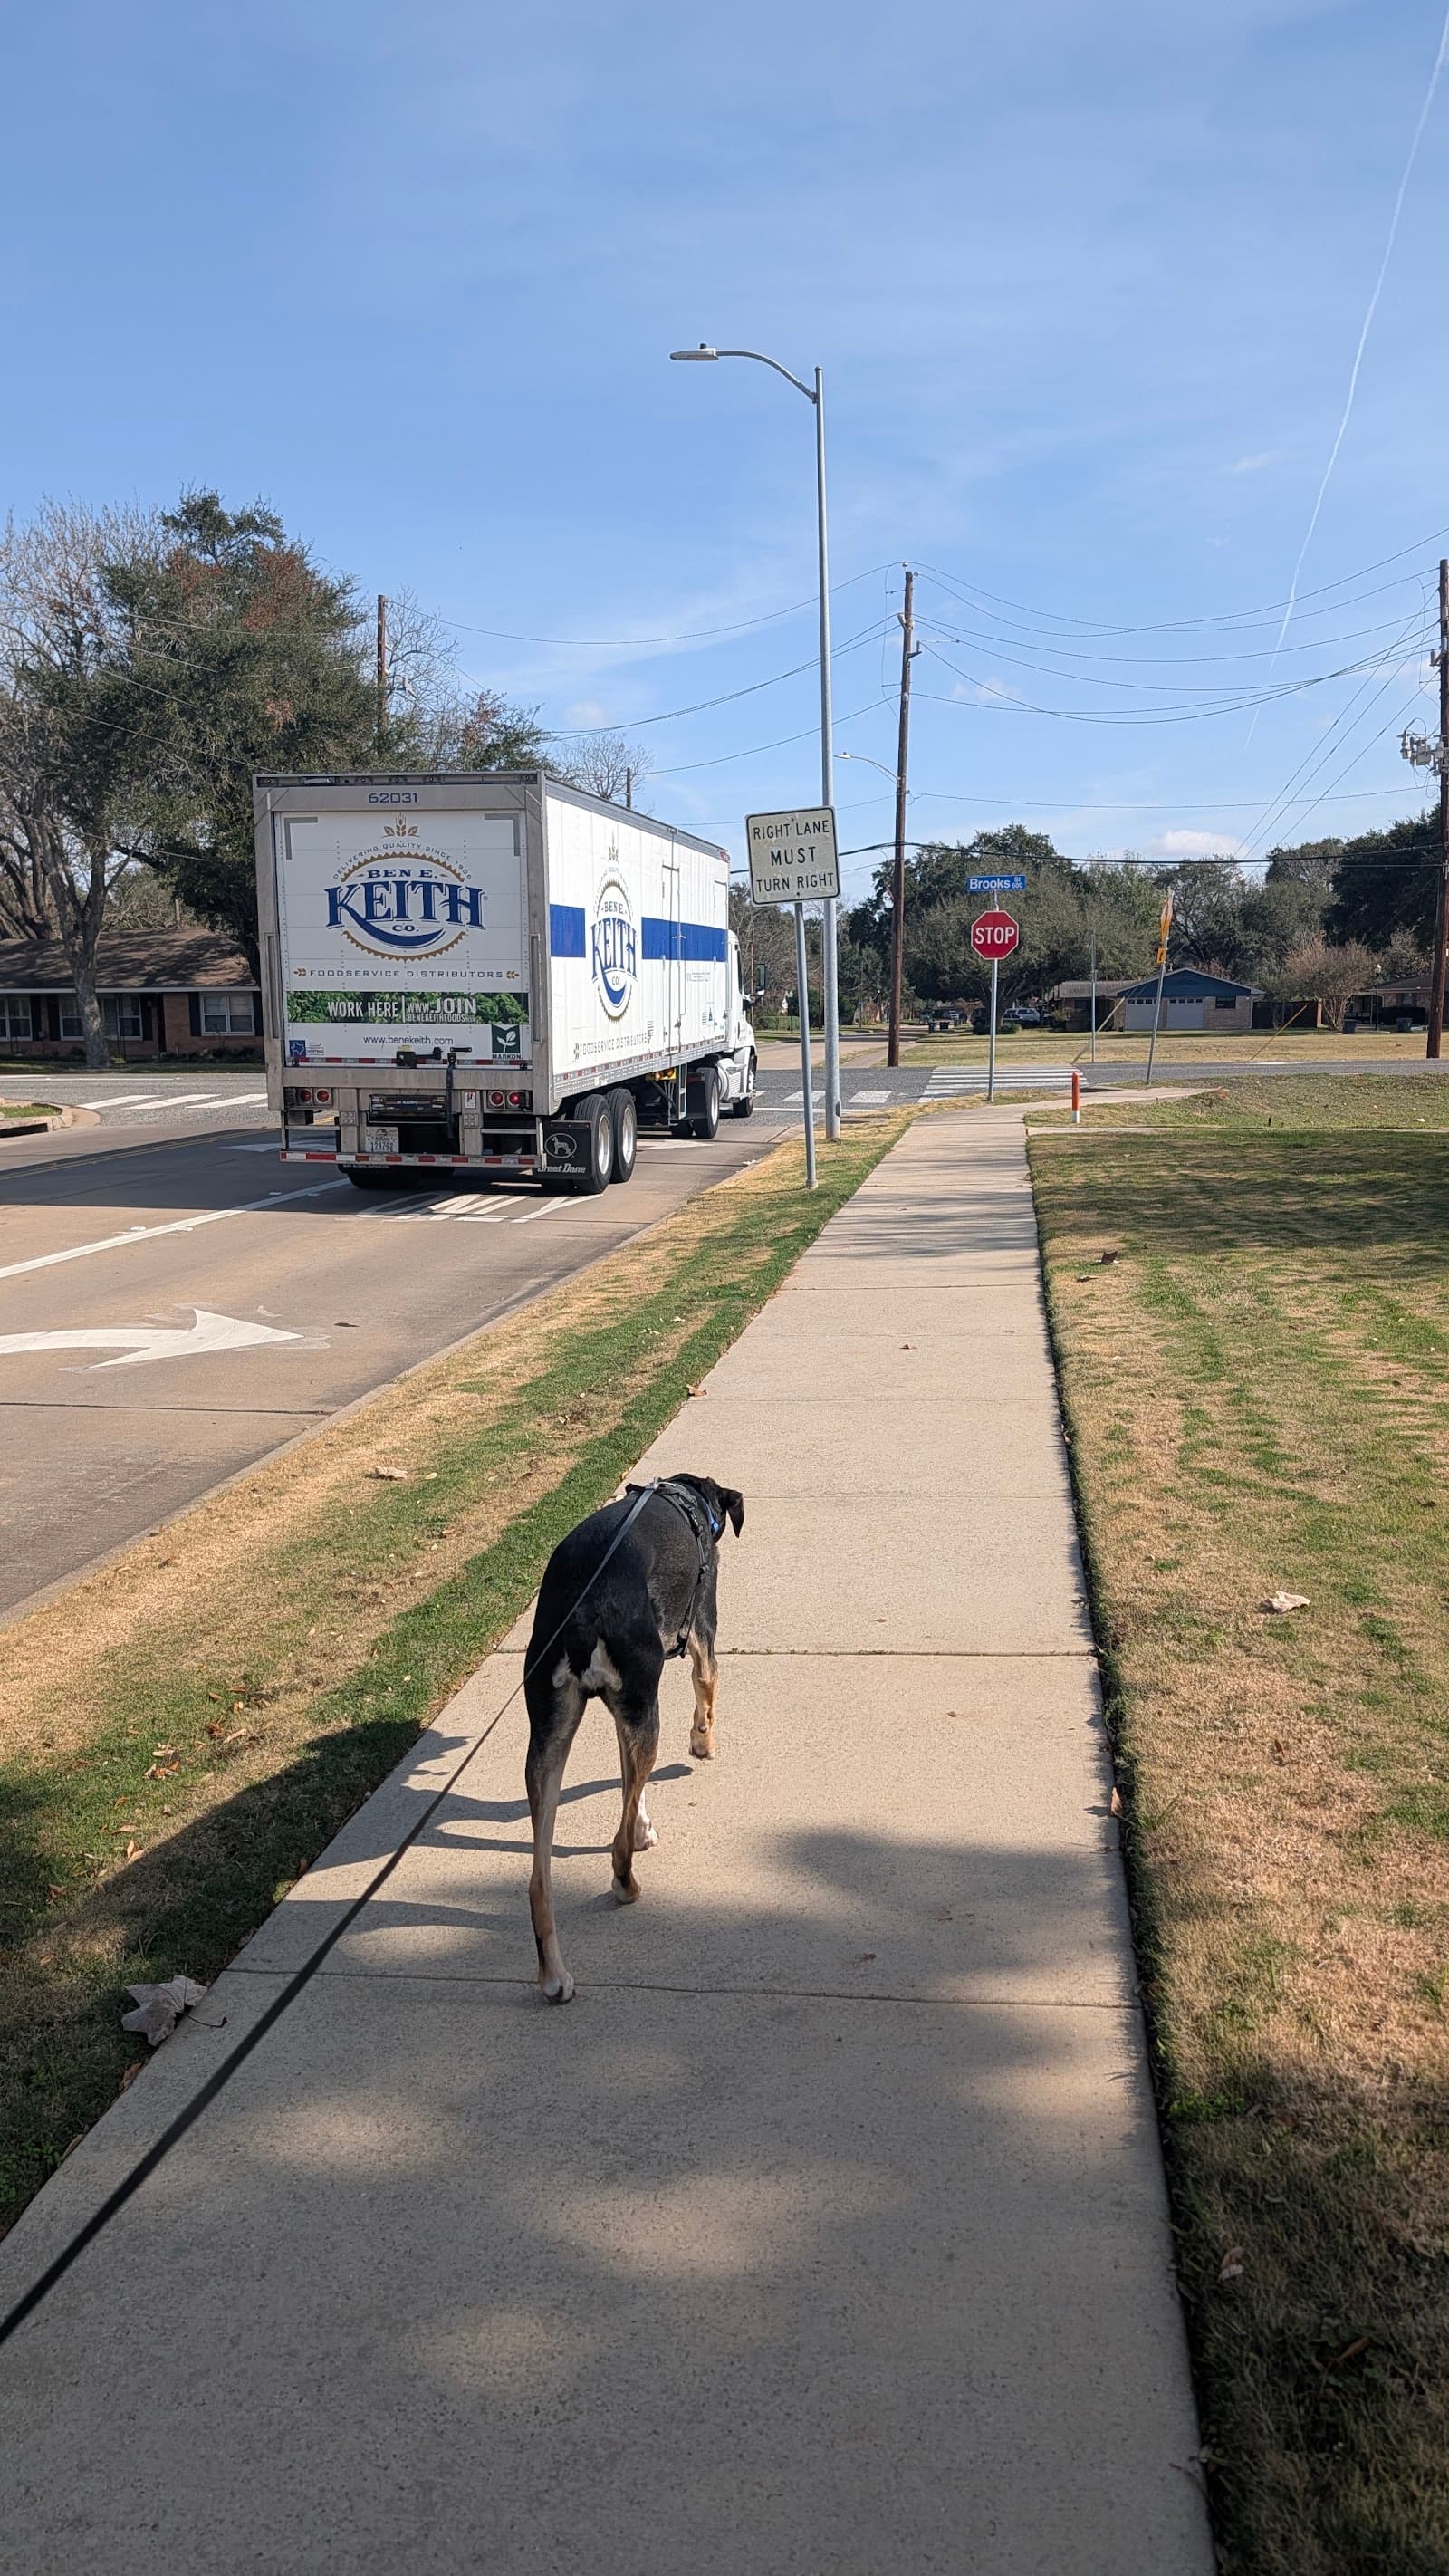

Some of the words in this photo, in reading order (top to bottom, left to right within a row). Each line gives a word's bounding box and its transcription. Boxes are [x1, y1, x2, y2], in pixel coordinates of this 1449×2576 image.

[368, 793, 418, 803] 62031
[753, 823, 791, 841] RIGHT
[795, 819, 830, 836] LANE
[332, 846, 379, 880] DELIVERING
[425, 845, 452, 861] SINCE
[770, 846, 817, 867] MUST
[367, 869, 414, 879] BEN
[418, 869, 438, 879] E.
[755, 876, 791, 893] TURN
[796, 872, 834, 889] RIGHT
[969, 878, 1011, 889] Brooks
[1011, 882, 1023, 890] 600
[324, 879, 486, 947] KEITH
[604, 900, 618, 913] BEN
[391, 924, 420, 932] CO.
[974, 926, 1015, 945] STOP
[590, 917, 638, 1004] KEITH
[309, 969, 401, 977] FOODSERVICE
[407, 970, 504, 978] DISTRIBUTORS
[327, 1001, 364, 1017] WORK
[367, 1001, 399, 1017] HERE
[363, 1035, 454, 1046] www.benekeith.com
[562, 1163, 587, 1174] Dane
[355, 1191, 604, 1224] ONLY
